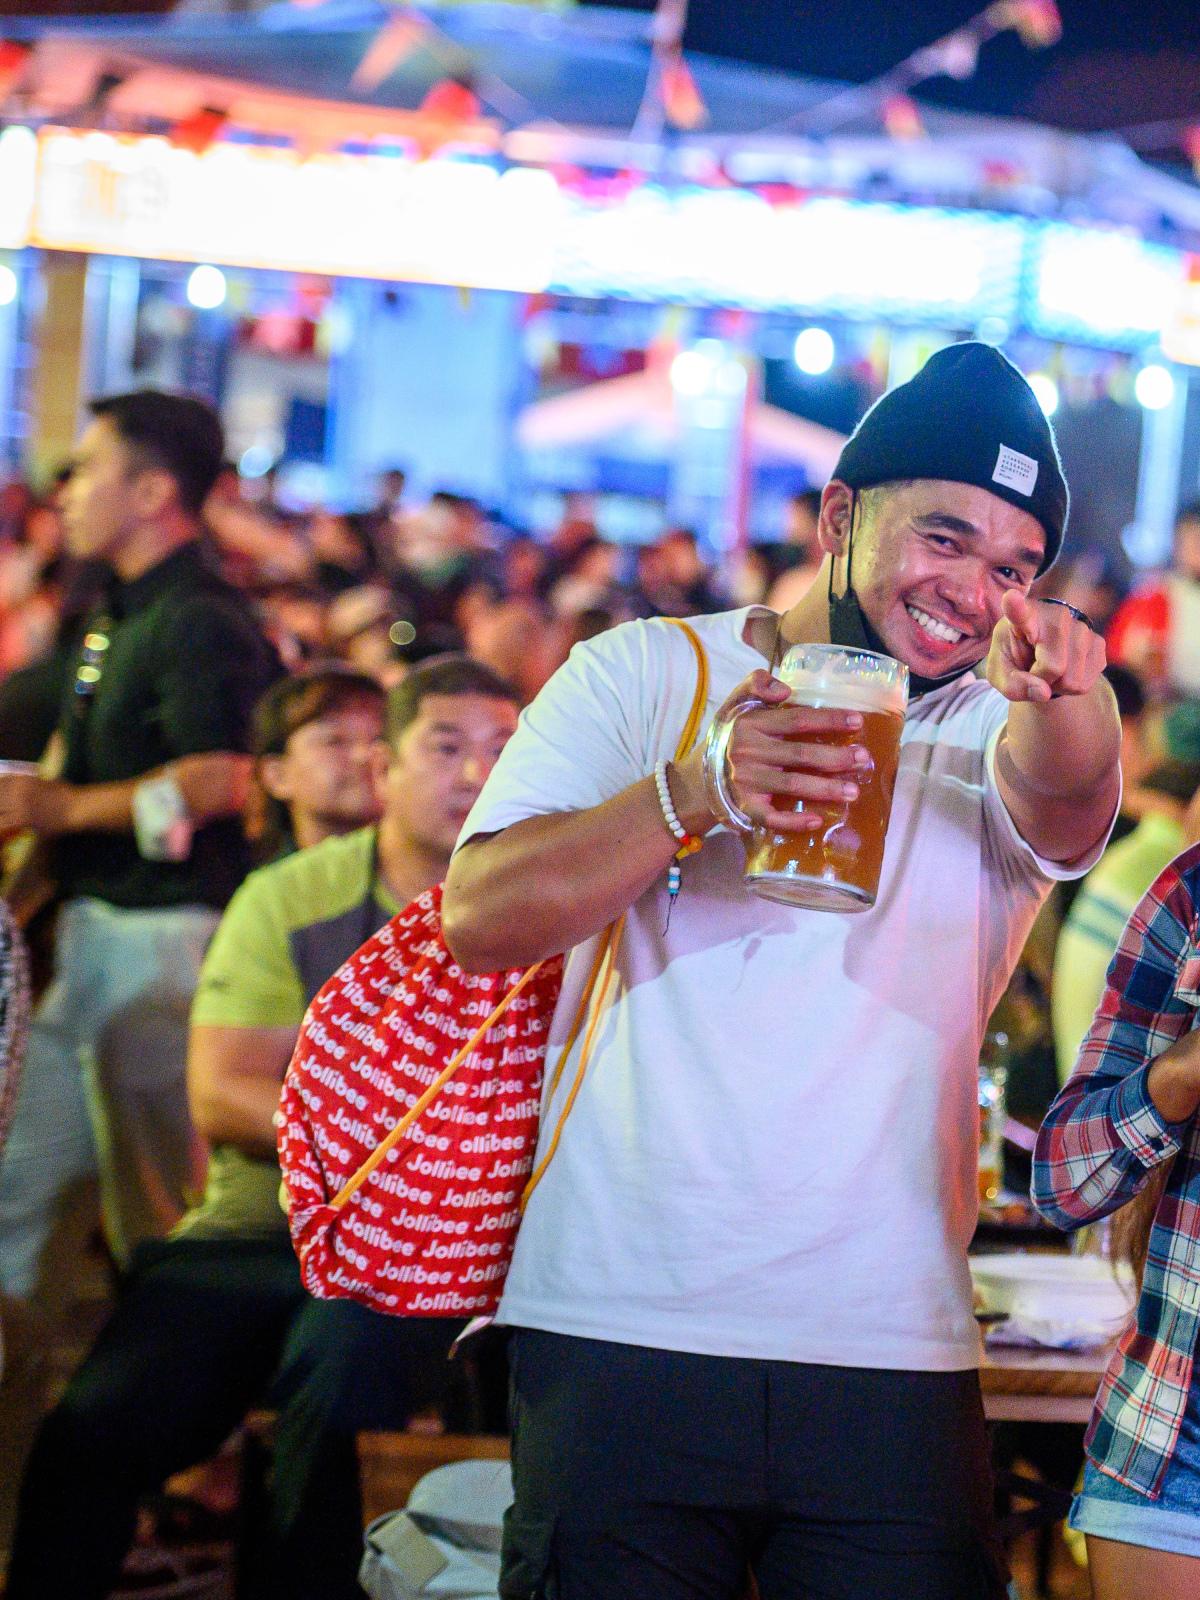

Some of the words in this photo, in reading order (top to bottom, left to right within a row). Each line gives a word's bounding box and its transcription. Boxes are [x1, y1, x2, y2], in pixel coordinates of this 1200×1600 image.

[306, 1020, 346, 1060] libee
[349, 1054, 419, 1110] Jollibee
[301, 1053, 368, 1113] Jollibee
[459, 1133, 526, 1154] ollibee
[367, 1170, 434, 1206] ollibee
[440, 1187, 517, 1208] Jollibee
[341, 1211, 416, 1258] Jollibee
[421, 1238, 503, 1260] Jollibee
[391, 1206, 472, 1235] Jollibee
[375, 1259, 454, 1285] Jollibee
[405, 1290, 490, 1311] Jollibee
